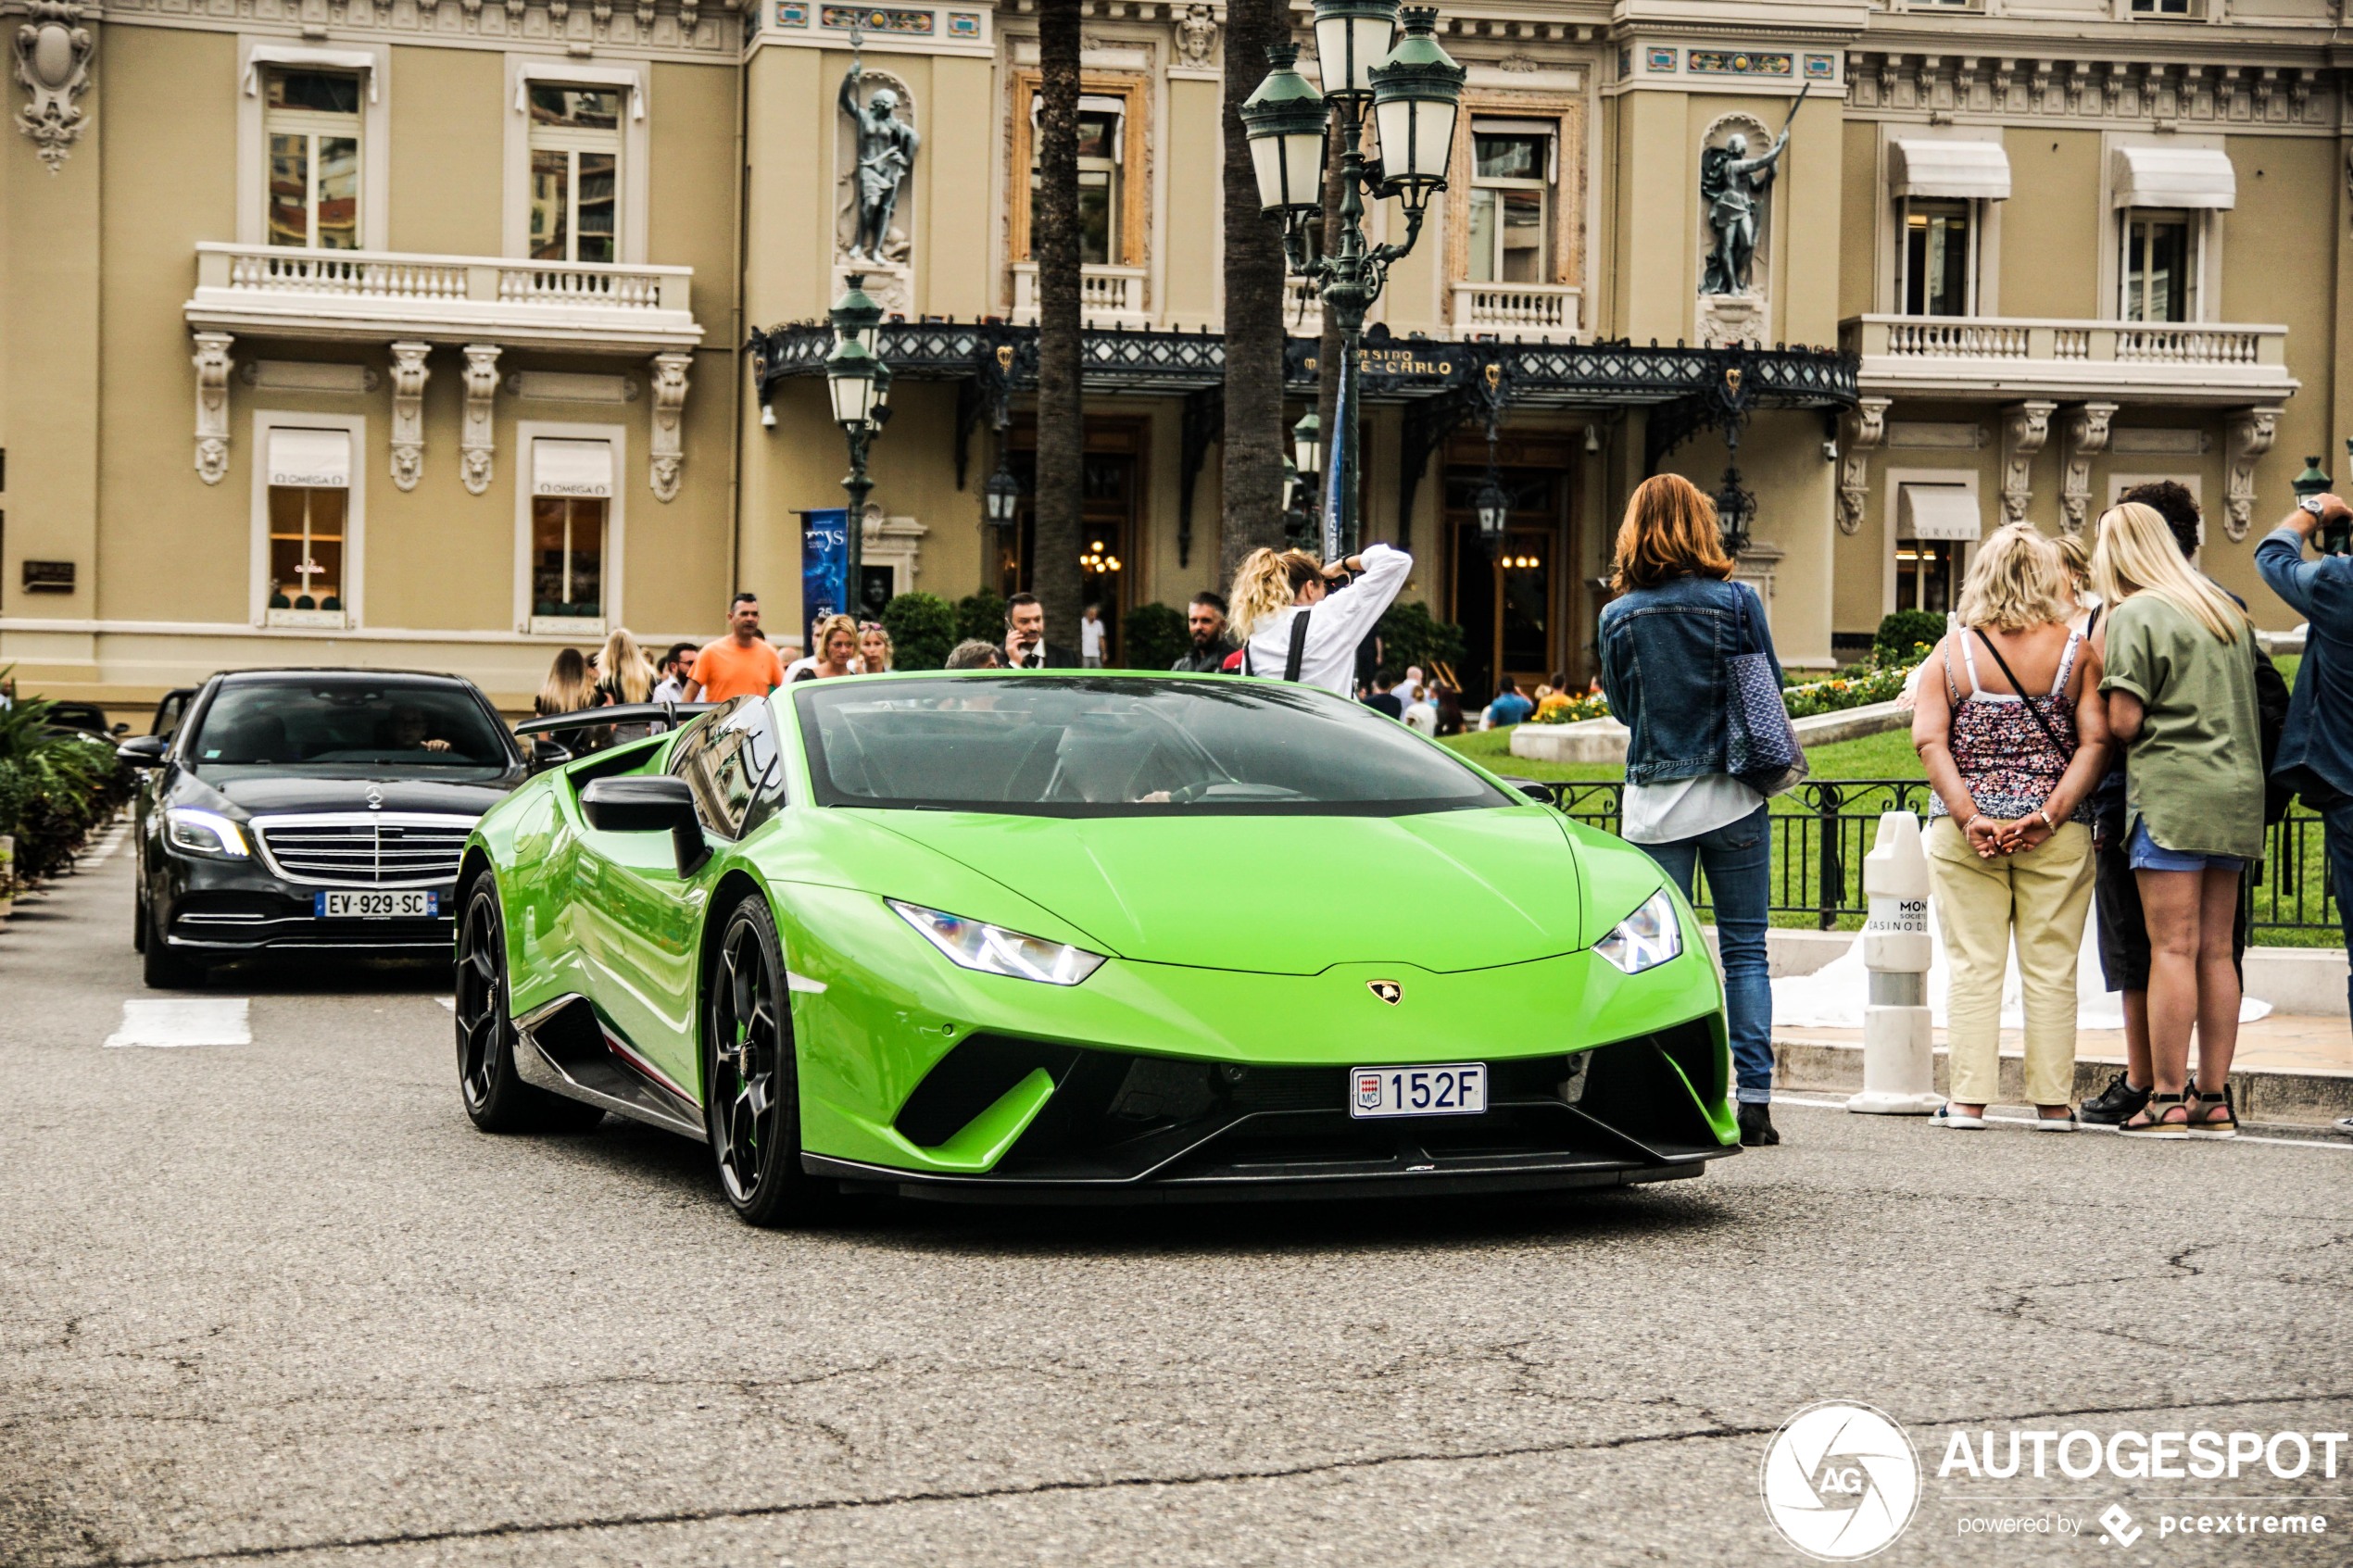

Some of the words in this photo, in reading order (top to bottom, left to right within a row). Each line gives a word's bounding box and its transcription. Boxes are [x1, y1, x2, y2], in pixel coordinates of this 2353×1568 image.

[1358, 349, 1413, 361] ASINO
[288, 474, 329, 484] OMEGA
[553, 485, 592, 495] OMEGA
[329, 895, 422, 913] EV-929-SC
[1869, 921, 1912, 932] CASINO
[1362, 1093, 1378, 1103] MC
[1392, 1071, 1478, 1110] 152F
